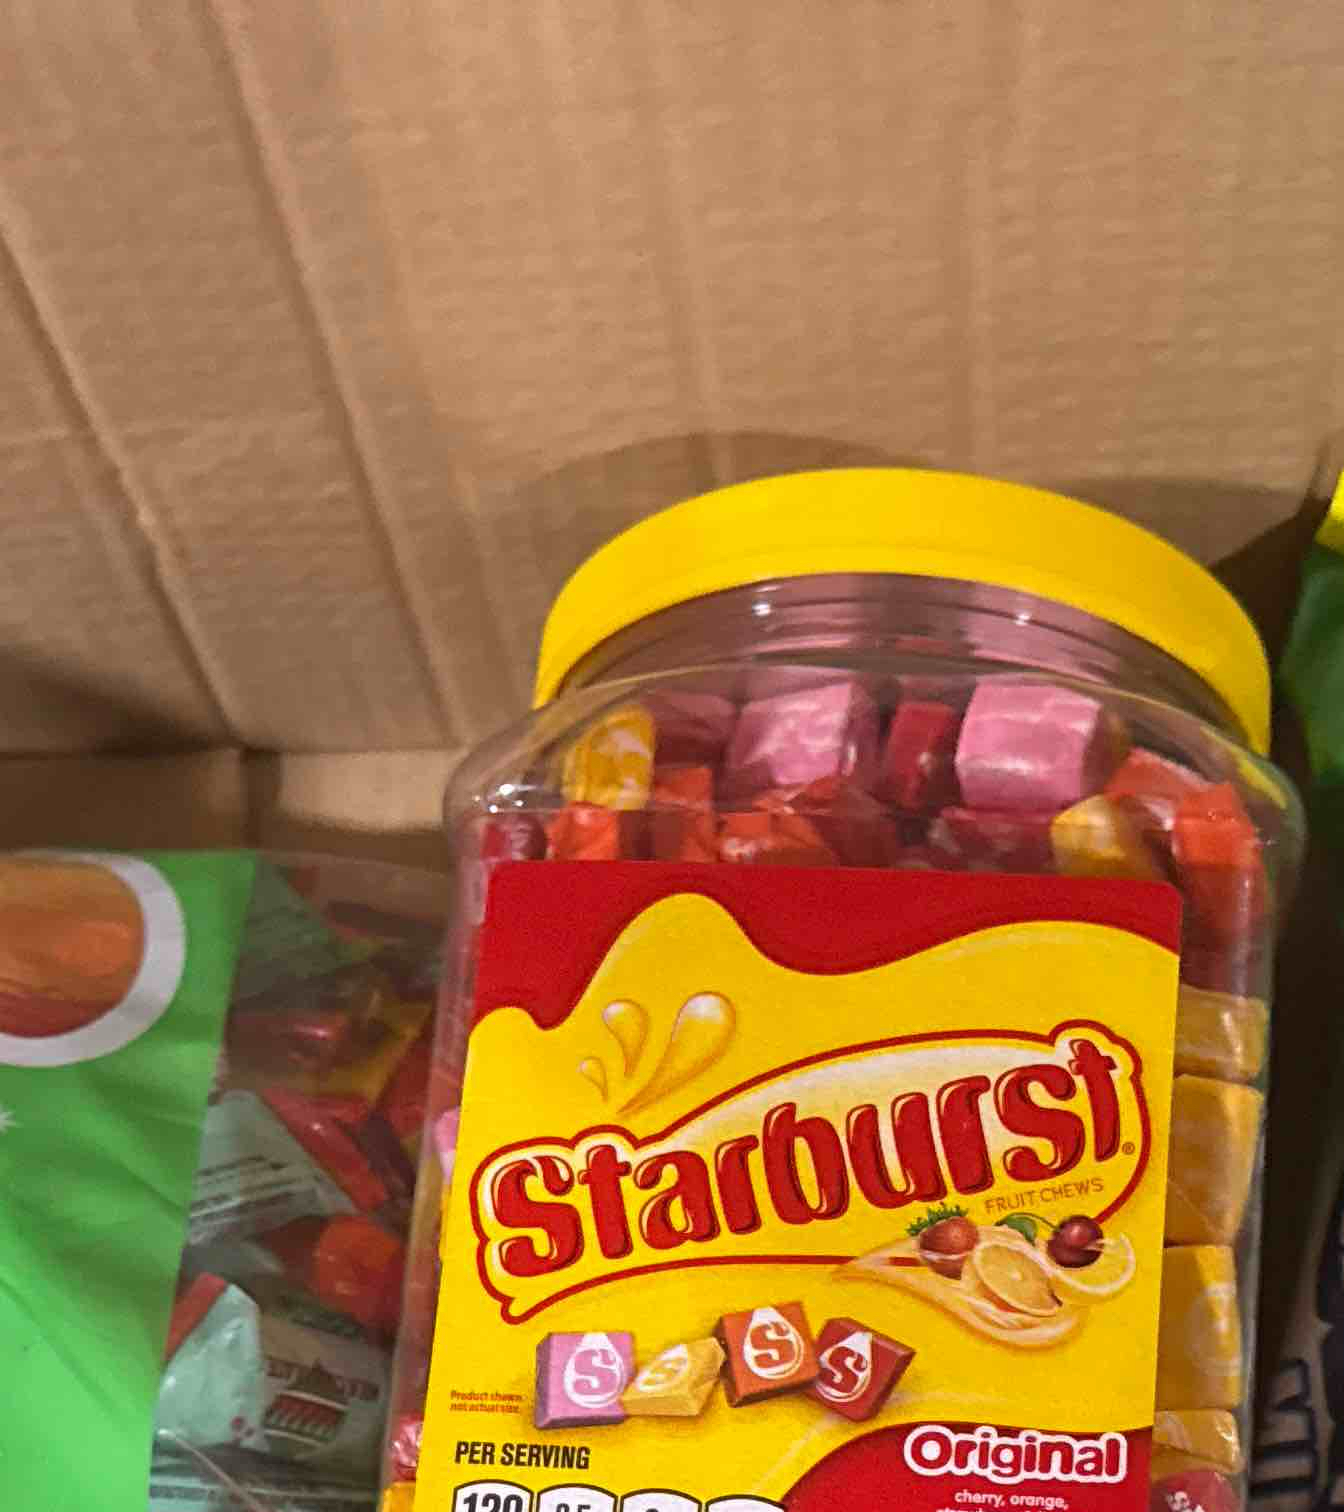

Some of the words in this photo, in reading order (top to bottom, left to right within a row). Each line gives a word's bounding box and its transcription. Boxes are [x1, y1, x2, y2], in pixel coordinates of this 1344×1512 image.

[985, 1190, 1040, 1215] FRUIT
[1041, 1177, 1105, 1204] CHEWS
[454, 1441, 496, 1465] PER
[500, 1442, 590, 1470] SERVING
[905, 1426, 1127, 1483] Original
[954, 1490, 1006, 1509] cherry,
[1009, 1494, 1070, 1512] orange,
